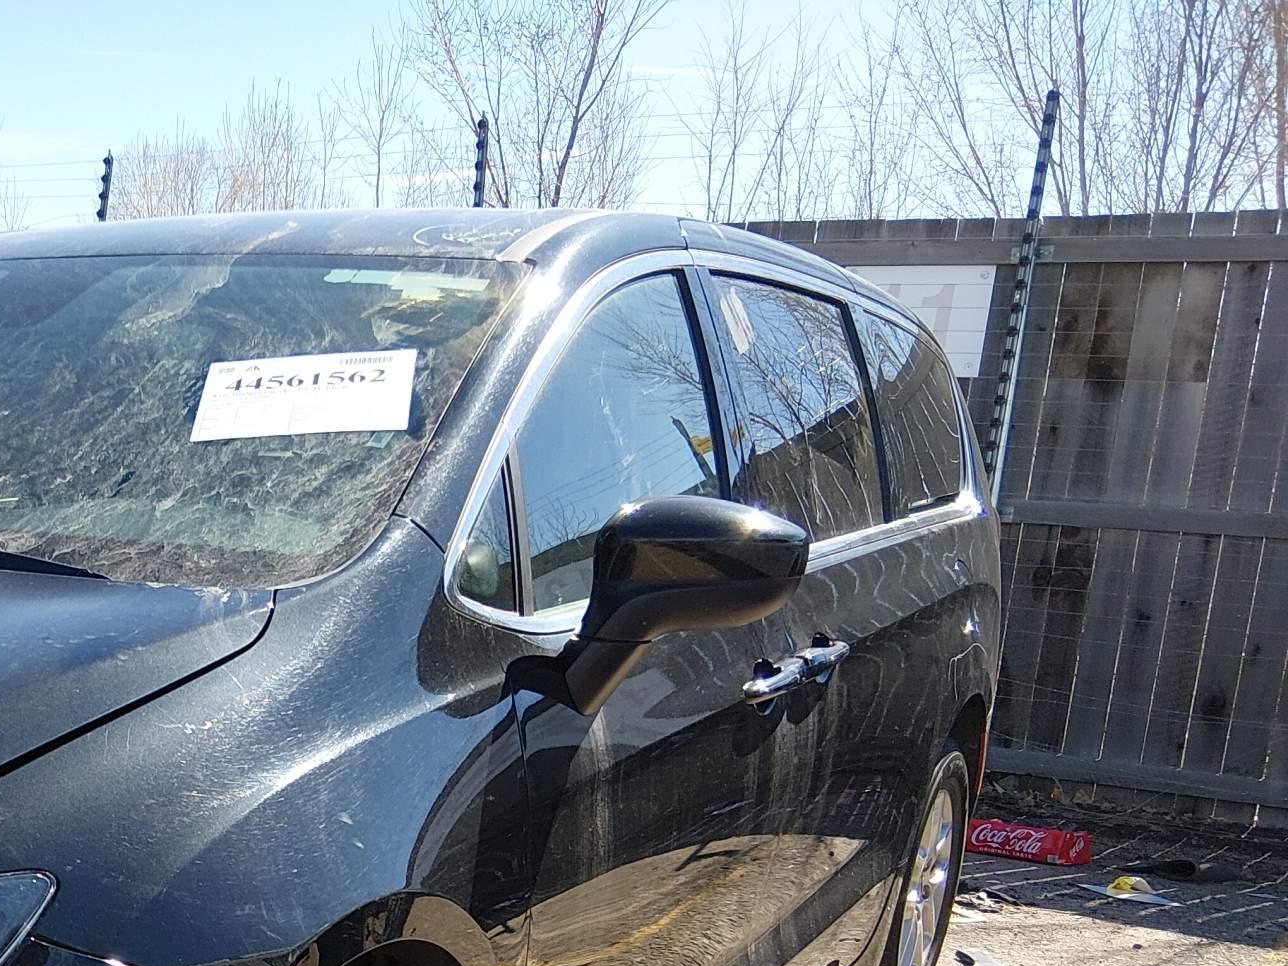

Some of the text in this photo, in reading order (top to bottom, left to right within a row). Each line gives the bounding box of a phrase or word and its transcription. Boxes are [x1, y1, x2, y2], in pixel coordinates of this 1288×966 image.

[225, 369, 386, 391] 44561562
[971, 823, 1048, 854] Coca-Cola
[979, 846, 1011, 856] ORIGINAL
